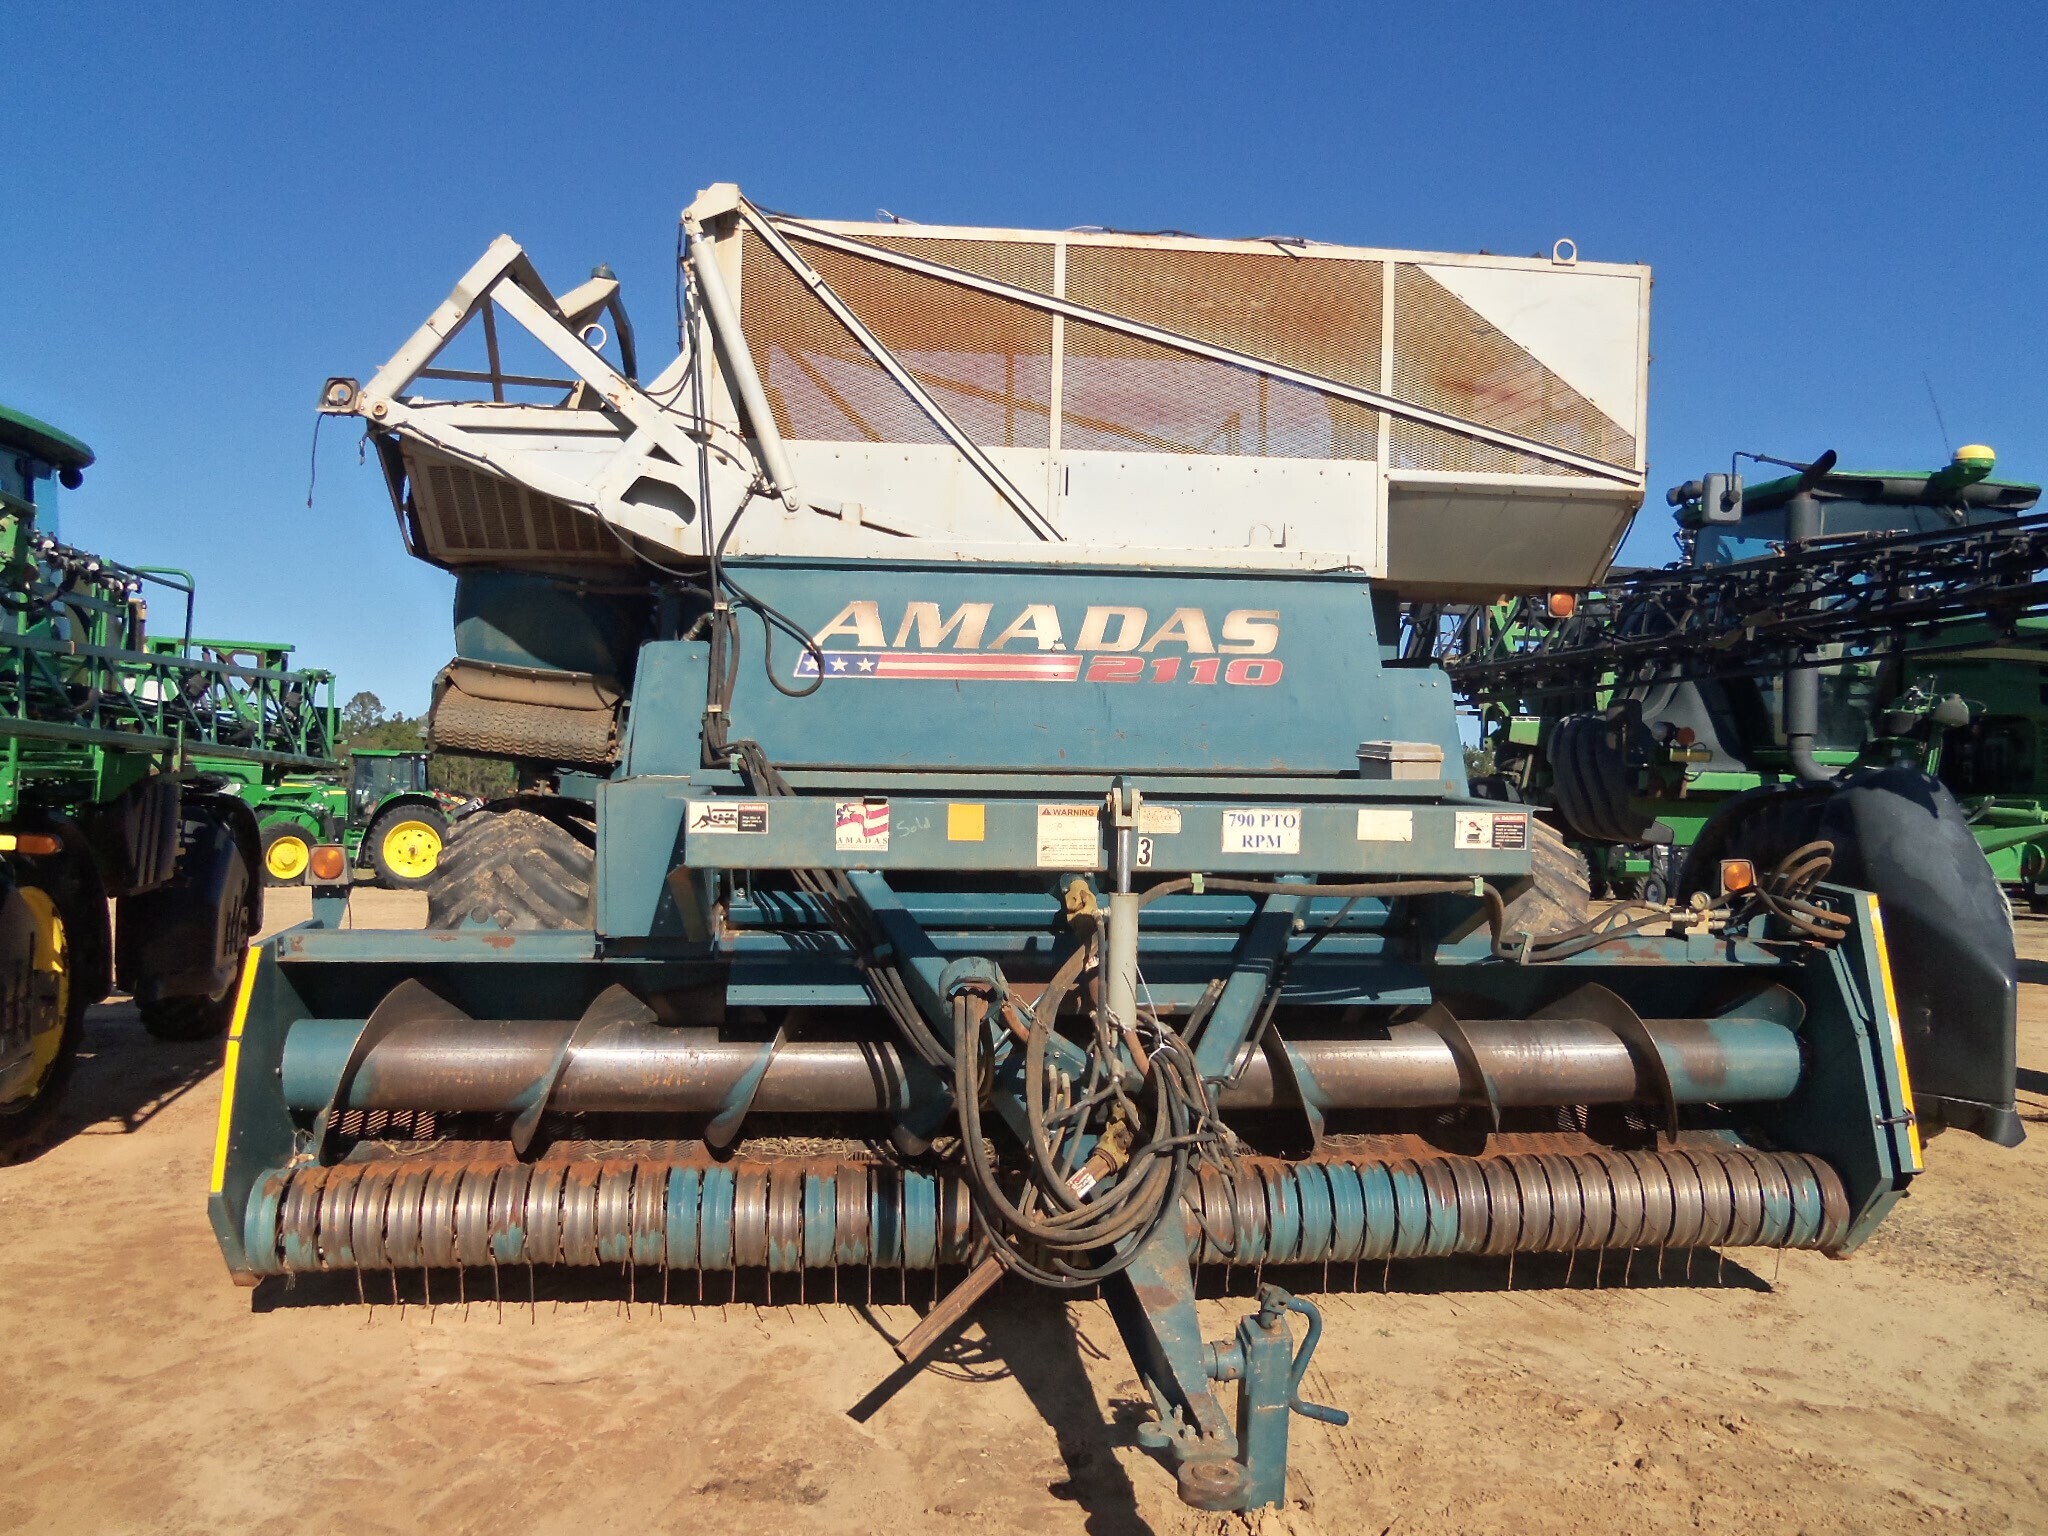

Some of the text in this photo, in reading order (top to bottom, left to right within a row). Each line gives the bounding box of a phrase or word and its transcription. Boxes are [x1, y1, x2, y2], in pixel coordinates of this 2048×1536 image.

[810, 600, 1280, 654] AMADAS
[1084, 655, 1284, 686] 2110
[1052, 808, 1095, 817] WARNING
[1228, 813, 1296, 828] 790 PTO
[896, 816, 931, 837] Sold
[836, 836, 888, 845] AMADAS
[1242, 834, 1281, 848] RPM
[1138, 838, 1151, 865] 3
